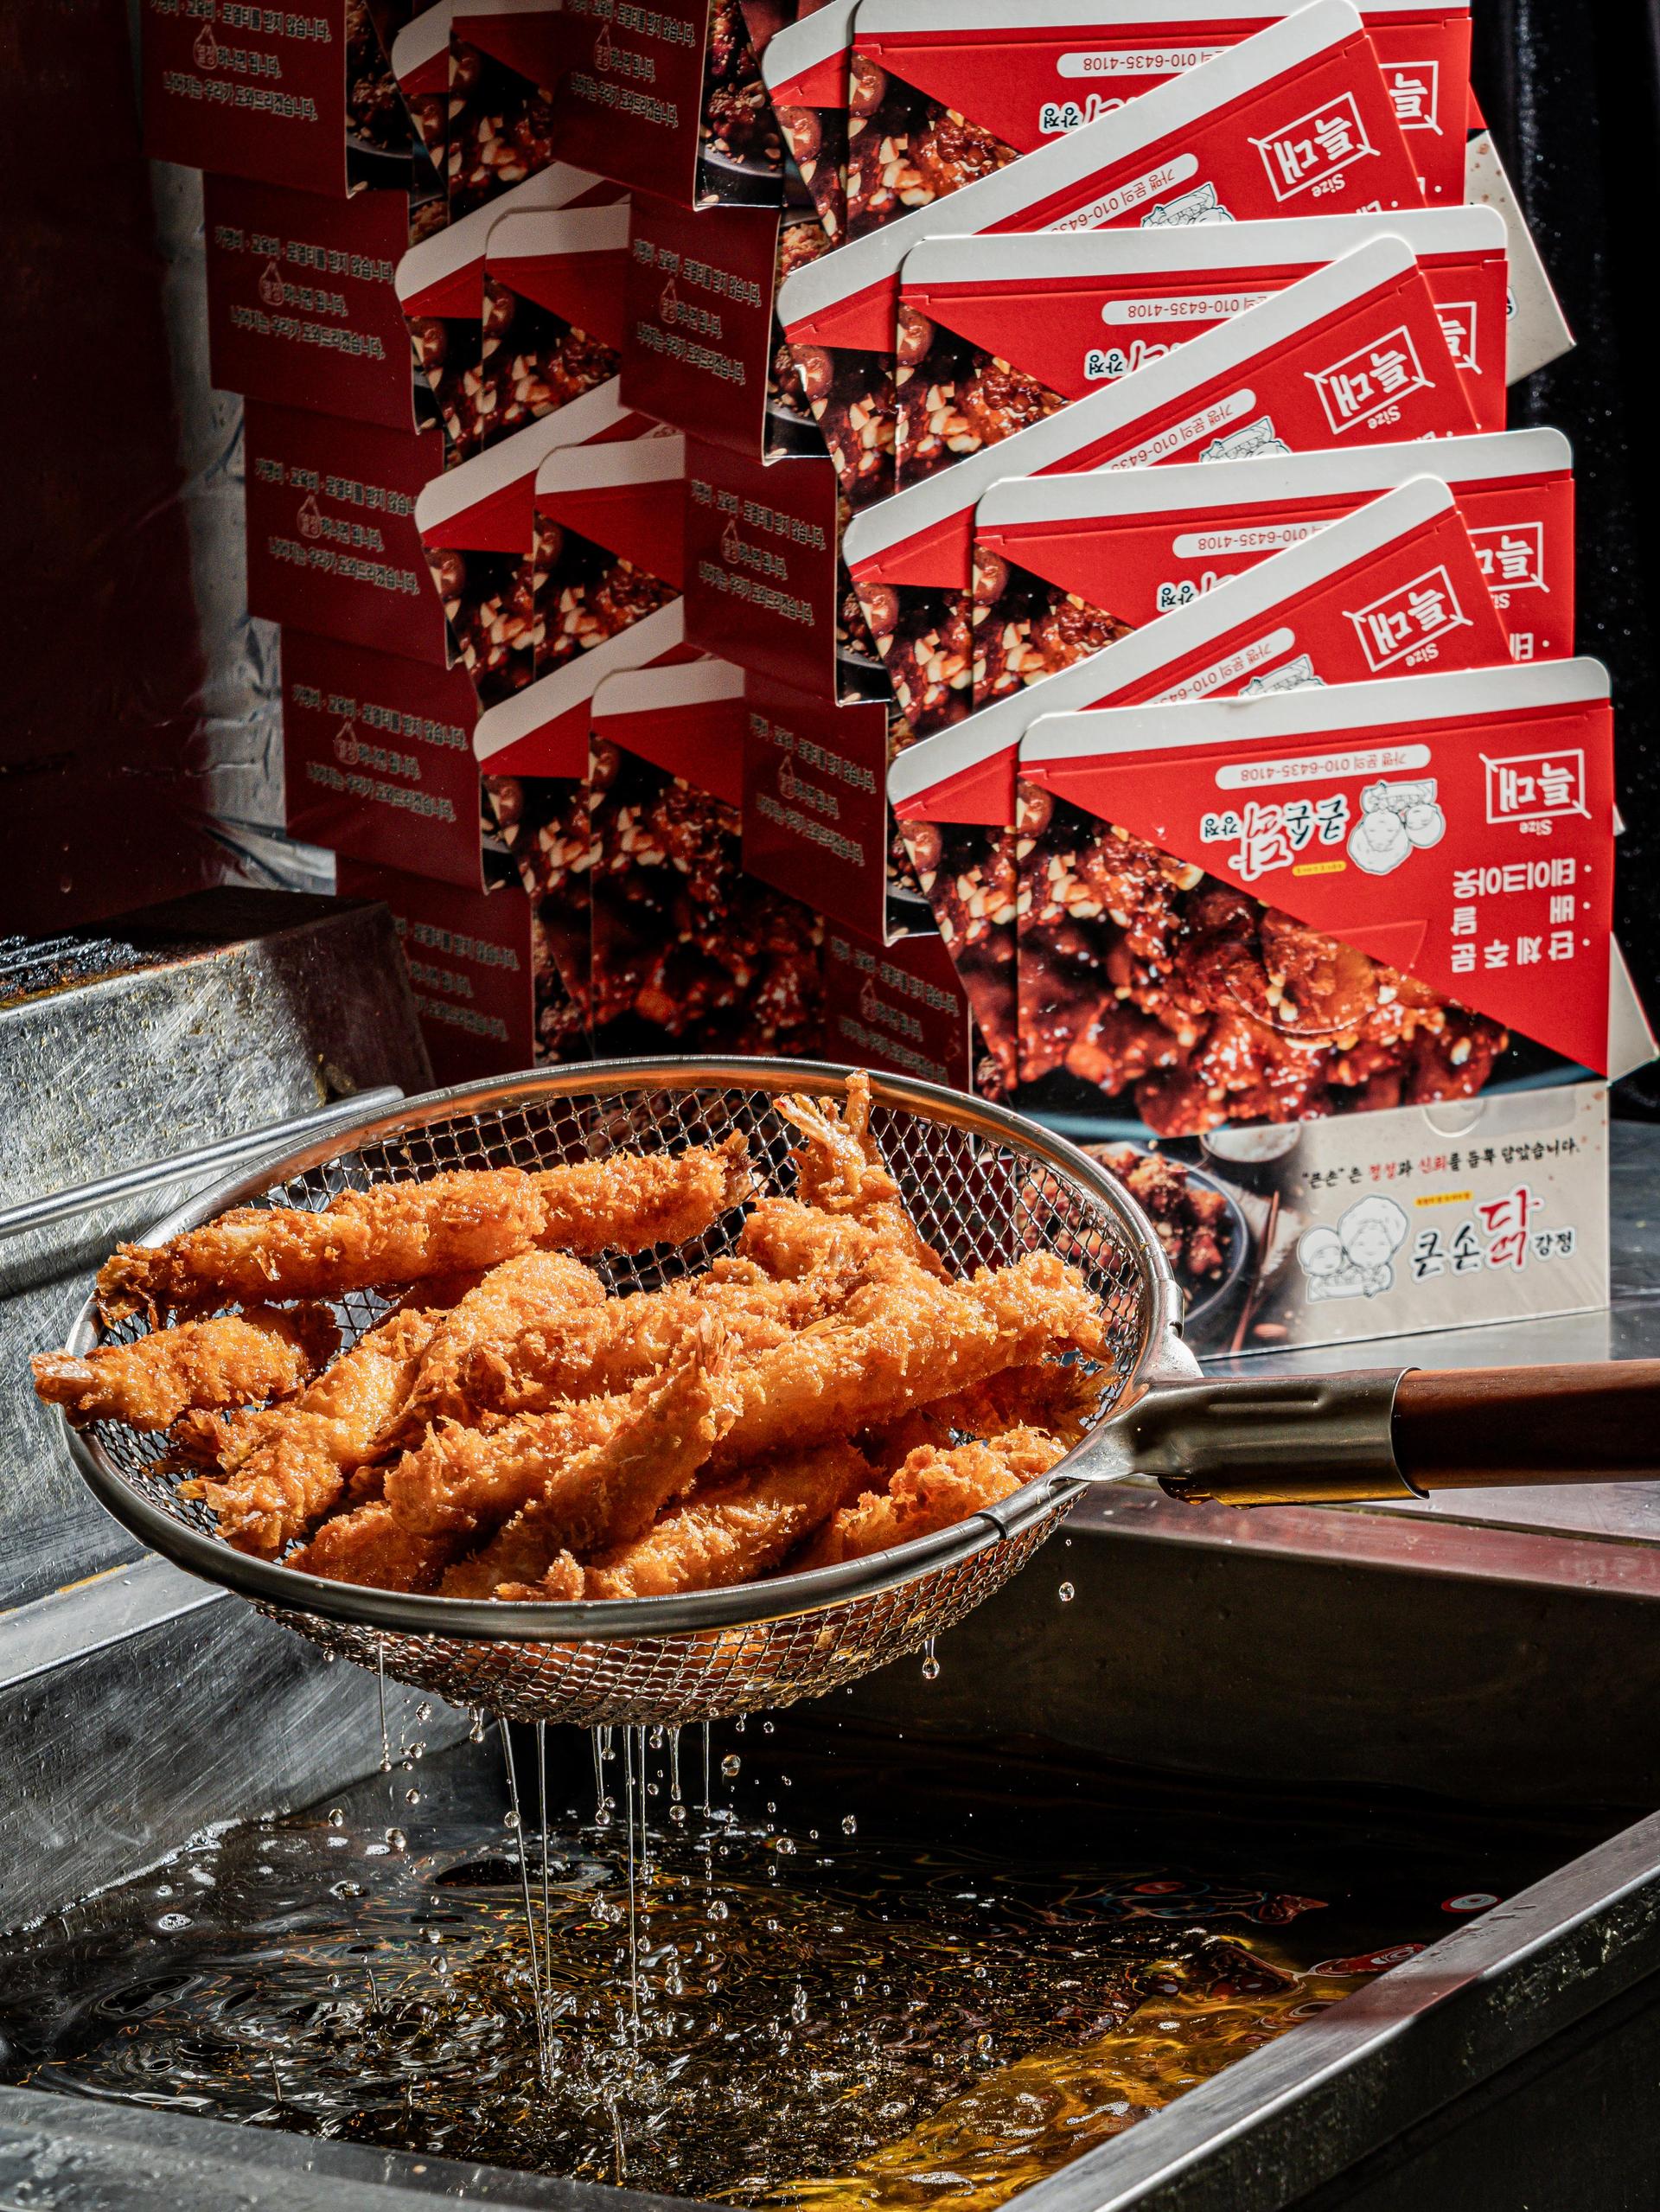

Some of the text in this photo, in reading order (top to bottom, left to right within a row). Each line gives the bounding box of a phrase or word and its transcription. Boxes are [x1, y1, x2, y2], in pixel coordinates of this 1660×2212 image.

[1083, 54, 1196, 70] 010-6435-4108
[1389, 73, 1428, 118] 특
[1043, 107, 1079, 129] 강정
[1271, 117, 1354, 184] 특대
[1149, 169, 1174, 192] 가맹
[1312, 174, 1345, 197] Size
[1120, 182, 1146, 203] 문의
[1127, 299, 1239, 317] 010-6435-4108
[1089, 354, 1123, 374] 강정
[1330, 350, 1409, 417] 특대
[1207, 404, 1233, 426] 가맹
[1367, 406, 1401, 429] Size
[1178, 418, 1204, 440] 문의
[1197, 528, 1307, 550] 010-6435-4108
[1490, 592, 1510, 609] Si
[1368, 589, 1447, 655] 특대
[1405, 643, 1439, 667] Size
[1241, 751, 1407, 781] 가맹 문의 010-6435-4108
[1499, 762, 1575, 813] 특대
[1204, 816, 1238, 836] 강정
[1519, 819, 1552, 836] Size
[1452, 858, 1575, 899] 테이크아웃
[1535, 1231, 1572, 1256] 강정
